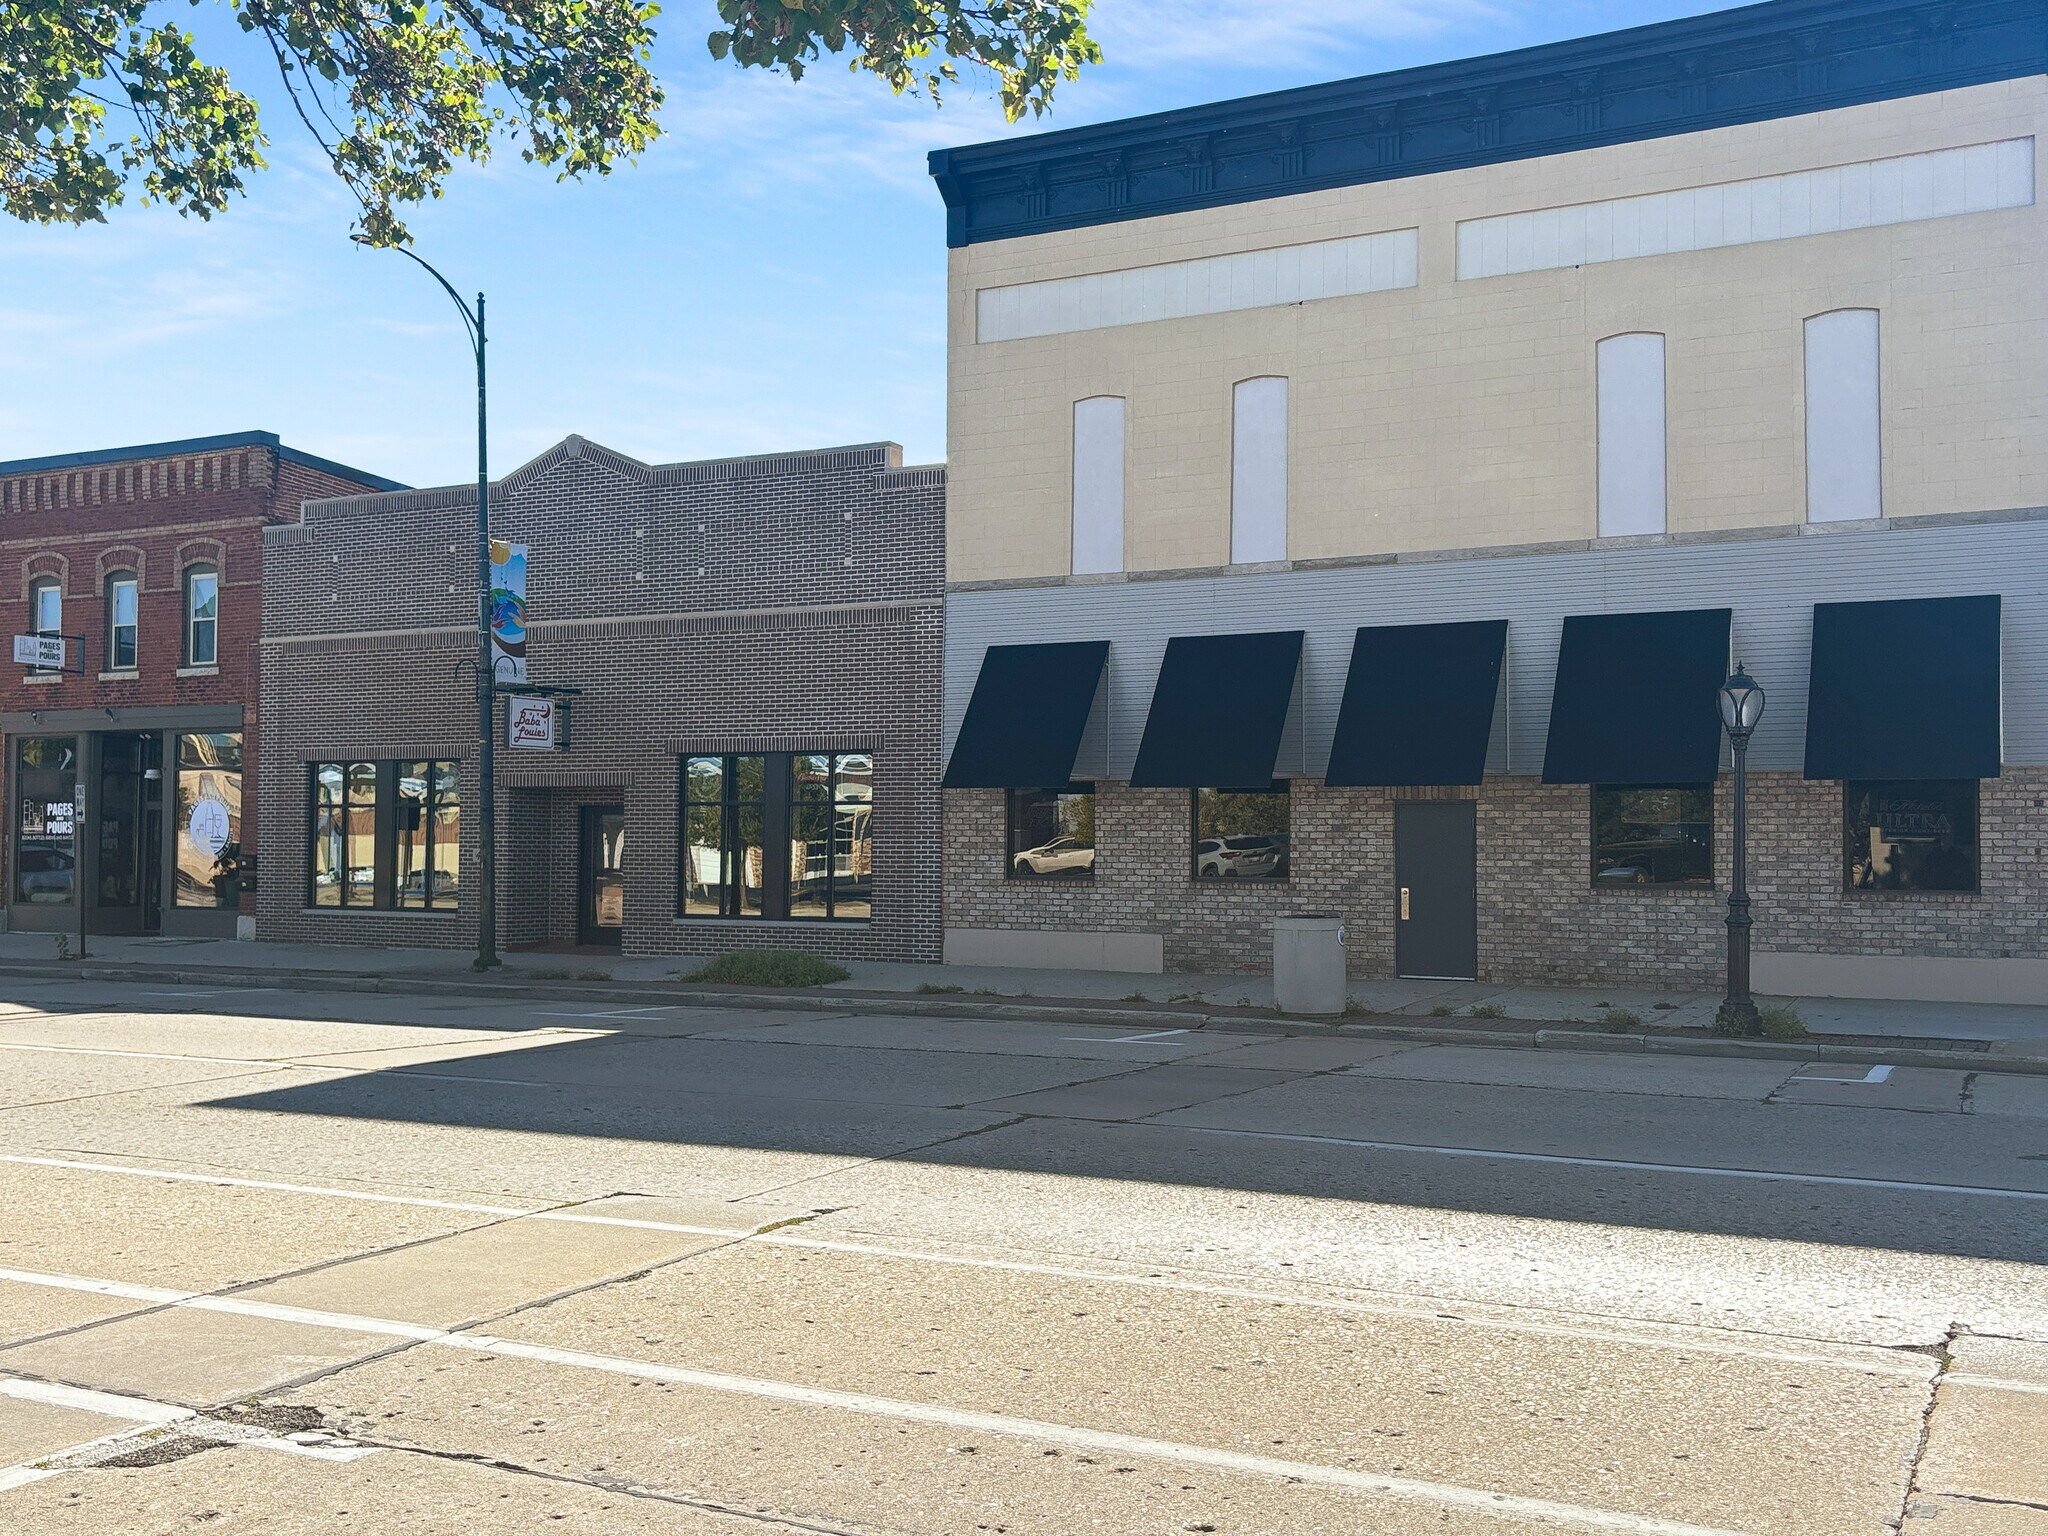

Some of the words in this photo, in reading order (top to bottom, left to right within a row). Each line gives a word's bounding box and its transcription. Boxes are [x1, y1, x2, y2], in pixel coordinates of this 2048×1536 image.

[39, 641, 61, 651] PAGES
[39, 652, 61, 661] POURS
[495, 665, 525, 676] GENUNE
[513, 708, 541, 728] Baba
[513, 726, 546, 743] Louies
[76, 786, 85, 797] ONE
[46, 803, 74, 816] PAGES
[46, 821, 73, 834] POURS
[1876, 813, 1952, 829] ULTRA
